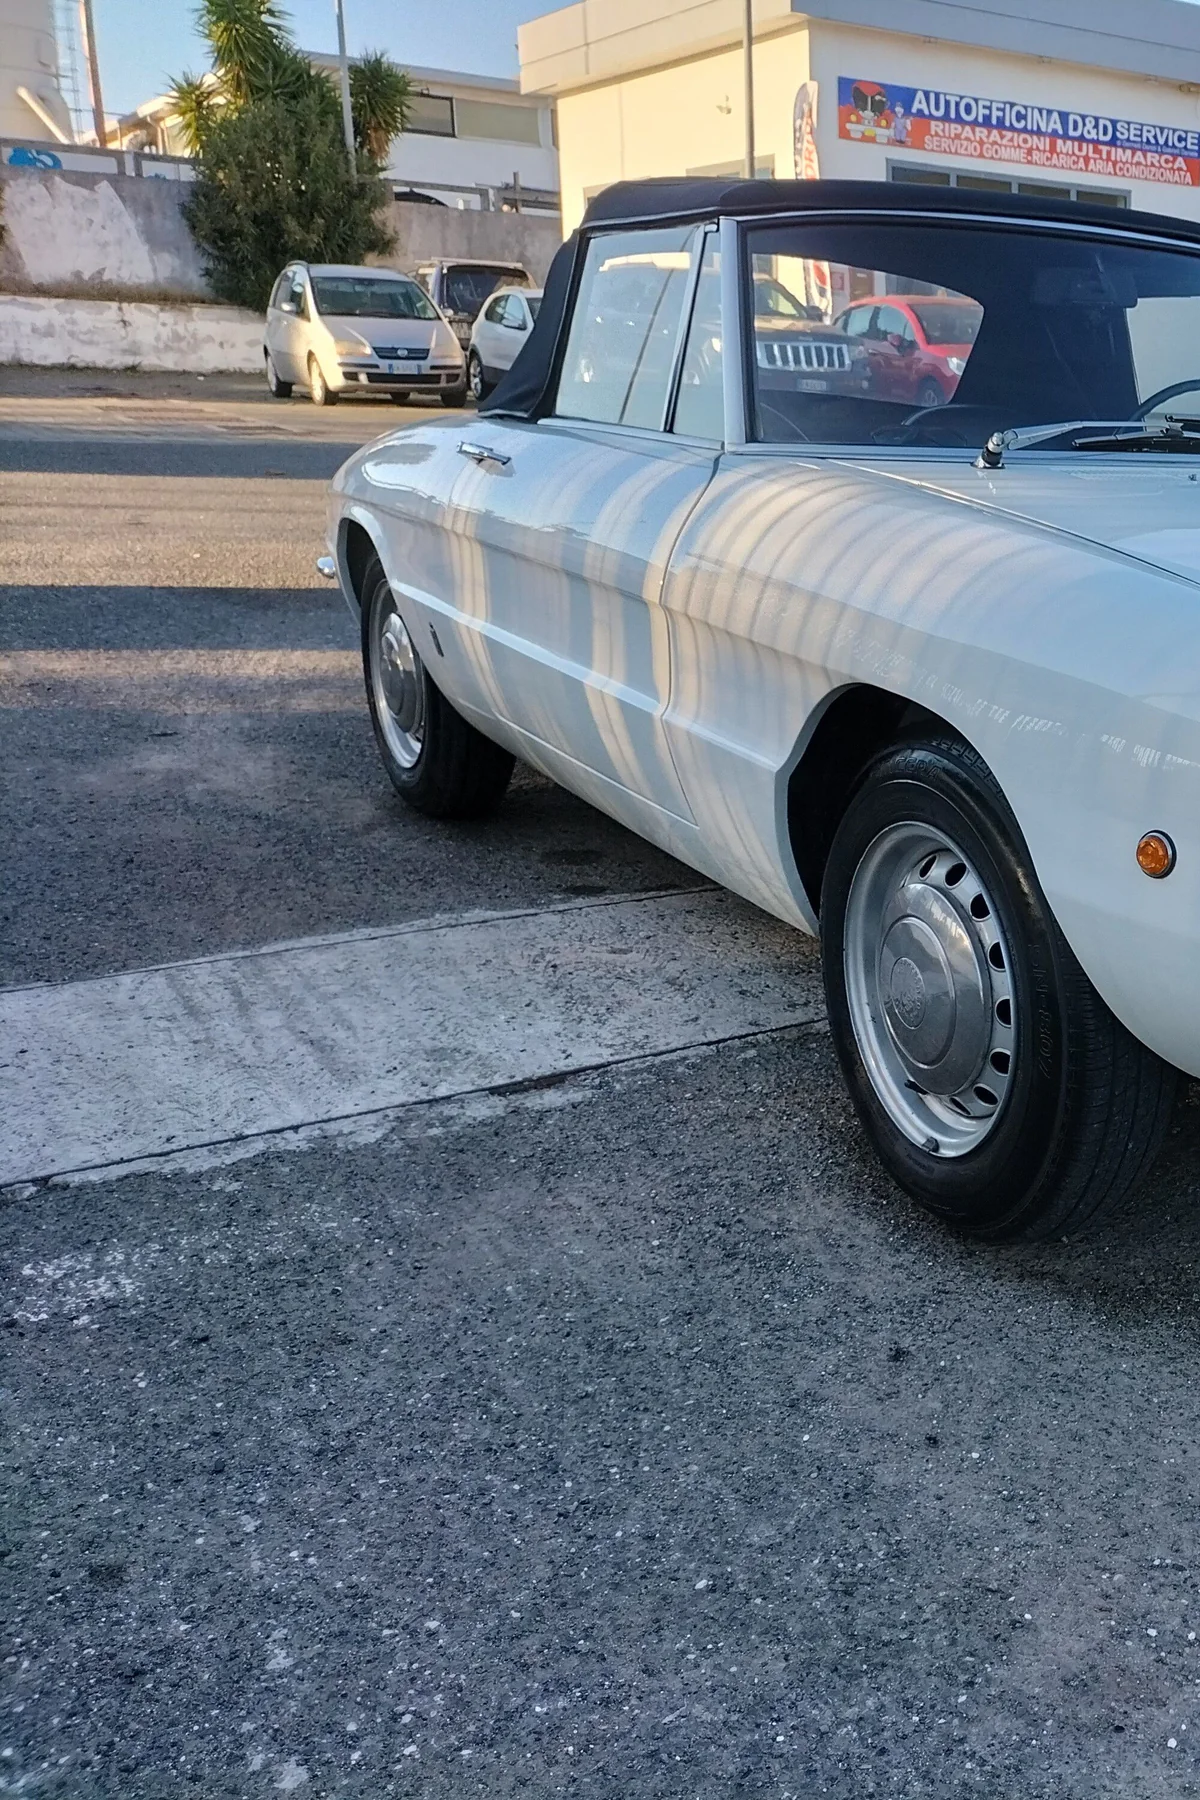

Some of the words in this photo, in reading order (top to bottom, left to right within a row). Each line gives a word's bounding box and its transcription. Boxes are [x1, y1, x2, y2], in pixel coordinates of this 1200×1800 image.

[911, 90, 1063, 135] AUTOFFICINA
[1068, 113, 1113, 142] D&D
[1116, 121, 1199, 151] SERVICE
[930, 120, 1050, 152] RIPARAZIONI
[1056, 138, 1188, 171] MULTIMARCA
[924, 135, 980, 157] SERVIZIO
[1088, 158, 1115, 175] ARIA
[1116, 162, 1193, 186] CONDIZIONATA
